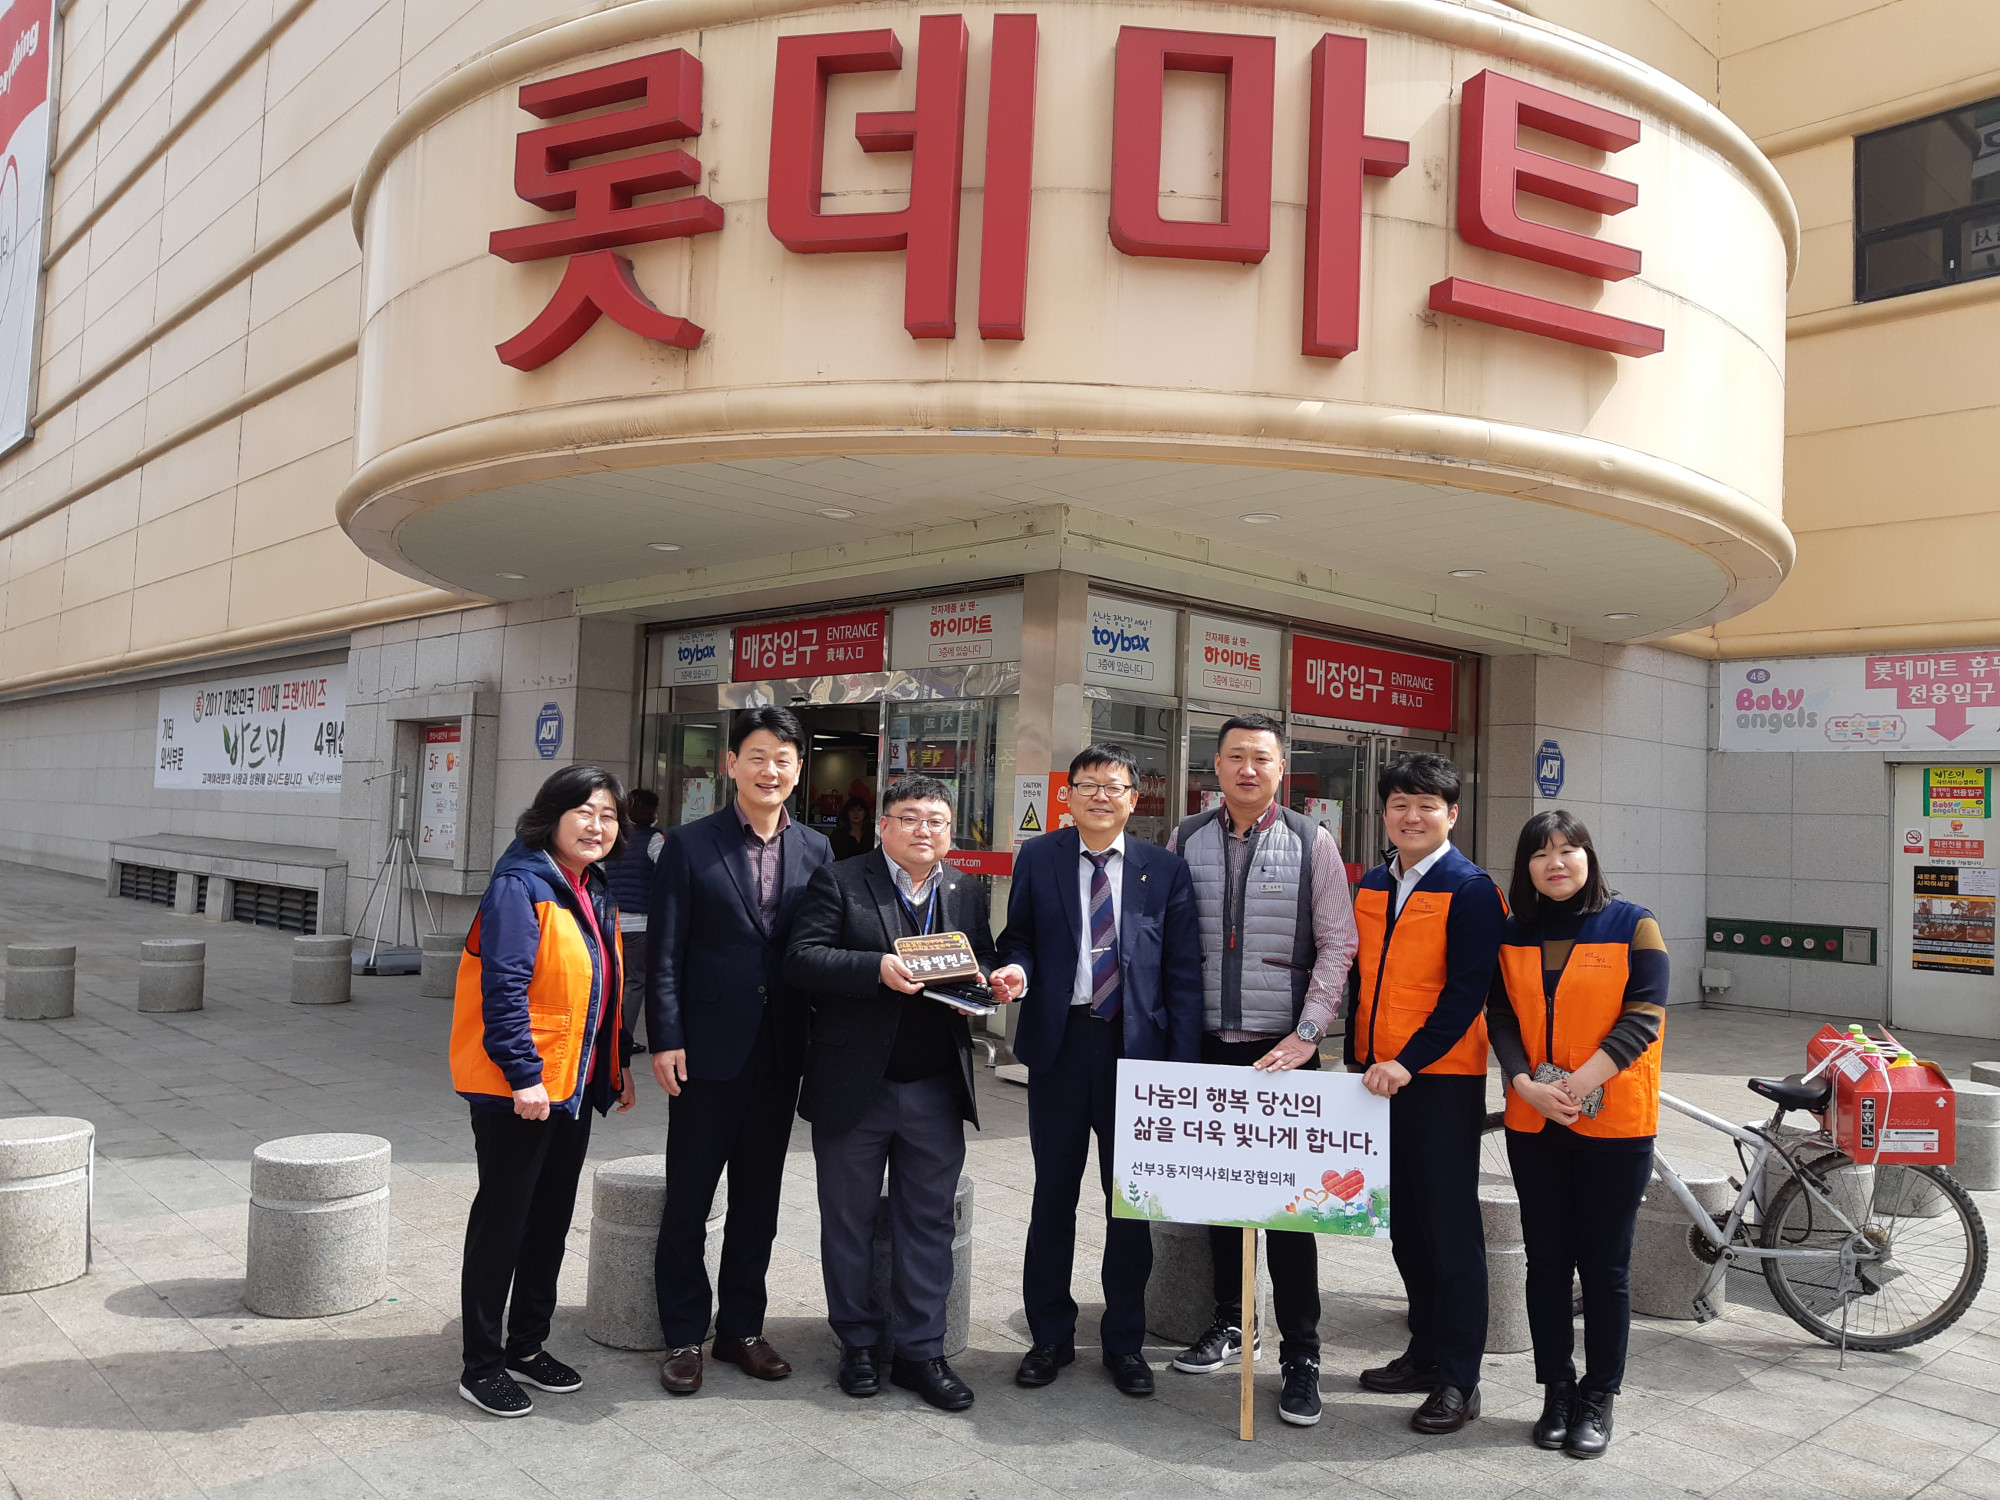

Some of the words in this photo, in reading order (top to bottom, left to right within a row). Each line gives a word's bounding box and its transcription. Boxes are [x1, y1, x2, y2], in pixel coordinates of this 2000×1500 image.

[488, 12, 1666, 373] 롯데마트
[931, 603, 957, 615] 전자제품
[959, 602, 966, 612] 살
[930, 614, 993, 638] 하이마트
[1092, 611, 1111, 625] 신나는
[1113, 614, 1133, 629] 장난감
[1134, 619, 1152, 631] 세상!
[826, 622, 879, 641] ENTRANCE
[1092, 625, 1151, 654] toybox
[1204, 631, 1230, 646] 전자제품
[1232, 636, 1239, 646] 살
[678, 644, 716, 665] toybox
[741, 628, 819, 668] 매장입구
[826, 646, 864, 662] 賣場入口
[938, 646, 954, 658] 3층에
[956, 644, 981, 657] 있습니다
[1097, 658, 1116, 672] 3층에
[1117, 660, 1144, 676] 있습니다
[1204, 645, 1262, 672] 하이마트
[1750, 671, 1767, 682] 4층
[1872, 658, 1960, 682] 롯데마트
[1212, 674, 1228, 687] 3층에
[1229, 676, 1252, 690] 있습니다
[1306, 658, 1385, 703] 매장입구
[1391, 671, 1434, 691] ENTRANCE
[204, 691, 223, 717] 2017
[223, 687, 255, 716] 대한민국
[257, 683, 280, 713] 100대
[281, 678, 328, 712] 프랜차이즈
[1391, 691, 1423, 708] 賣場入口
[1736, 687, 1805, 711] Baby
[1907, 682, 1996, 705] 전용입구
[161, 718, 175, 742] 기타
[539, 720, 559, 740] ADT
[1736, 706, 1818, 734] angels
[222, 717, 286, 771] 바르미
[160, 746, 184, 771] 외식부문
[428, 752, 440, 771] 5F
[201, 772, 232, 785] 고객여러분의
[231, 772, 248, 785] 사랑과
[249, 772, 266, 785] 성원에
[1540, 759, 1560, 780] ADT
[1934, 769, 1965, 779] 바르미
[1022, 781, 1042, 789] CAUTION
[1022, 790, 1042, 798] 안전수칙
[1953, 788, 1982, 797] 전용입구
[822, 815, 837, 823] CARE
[1932, 807, 1957, 815] angels
[423, 825, 434, 843] 2F
[1934, 840, 1962, 849] 회원전용
[1916, 880, 1951, 888] 시작하세요
[905, 952, 972, 972] 나눔발전소
[1134, 1083, 1198, 1110] 나눔의
[1205, 1086, 1250, 1115] 행복
[1257, 1090, 1322, 1118] 당신의
[1133, 1115, 1177, 1143] 삶을
[1183, 1119, 1227, 1147] 더욱
[1233, 1122, 1298, 1150] 빛나게
[1305, 1127, 1379, 1157] 합니다.
[1130, 1160, 1296, 1188] 선부3동지역사회보장협의체
